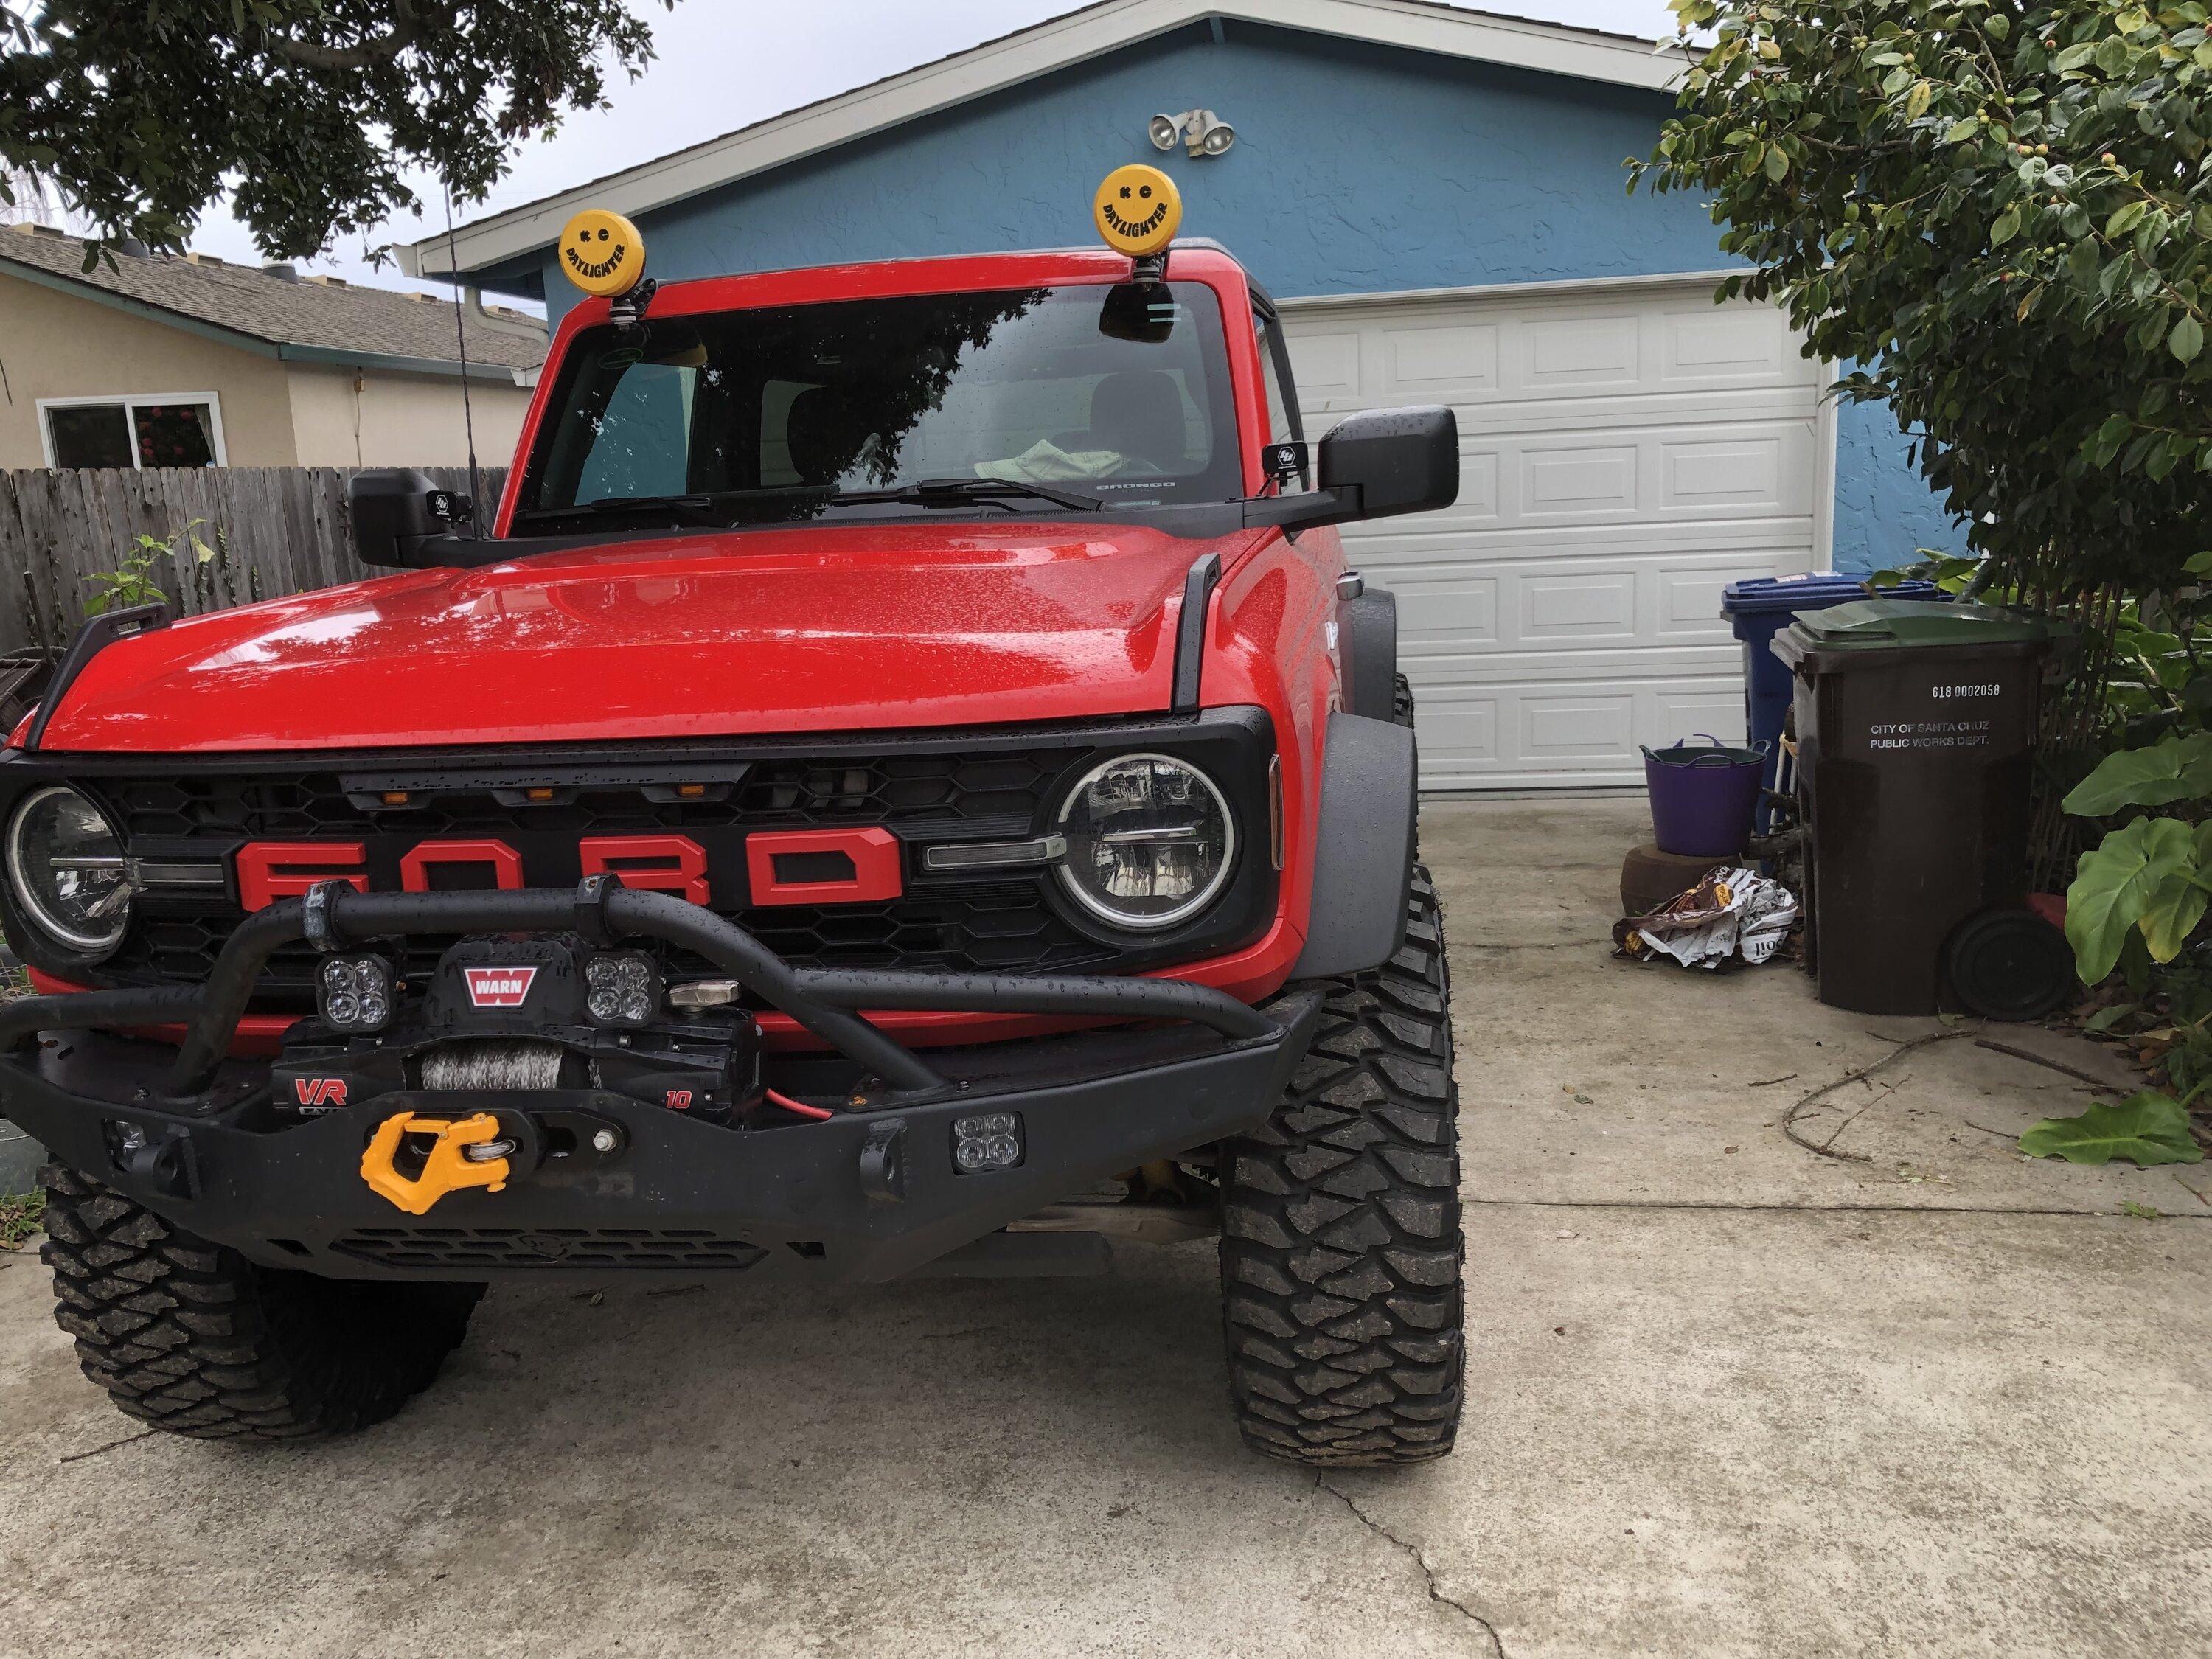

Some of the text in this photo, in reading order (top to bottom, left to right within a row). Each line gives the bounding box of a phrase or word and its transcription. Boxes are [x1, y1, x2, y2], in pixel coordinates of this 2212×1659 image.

[1103, 202, 1168, 237] DAYLIGHTER
[566, 244, 625, 278] DAYLIGHTER
[1096, 482, 1175, 490] BRONCO
[1933, 684, 2000, 698] 618 0002058
[1871, 725, 1896, 734] CITY
[1899, 724, 1916, 734] OF
[1917, 723, 1955, 733] SANTA
[1871, 736, 1989, 748] PUBLIC WORKS DEPT.
[236, 827, 902, 912] FORD
[476, 980, 522, 994] WARN
[295, 1079, 347, 1105] VR
[666, 1090, 692, 1109] 10
